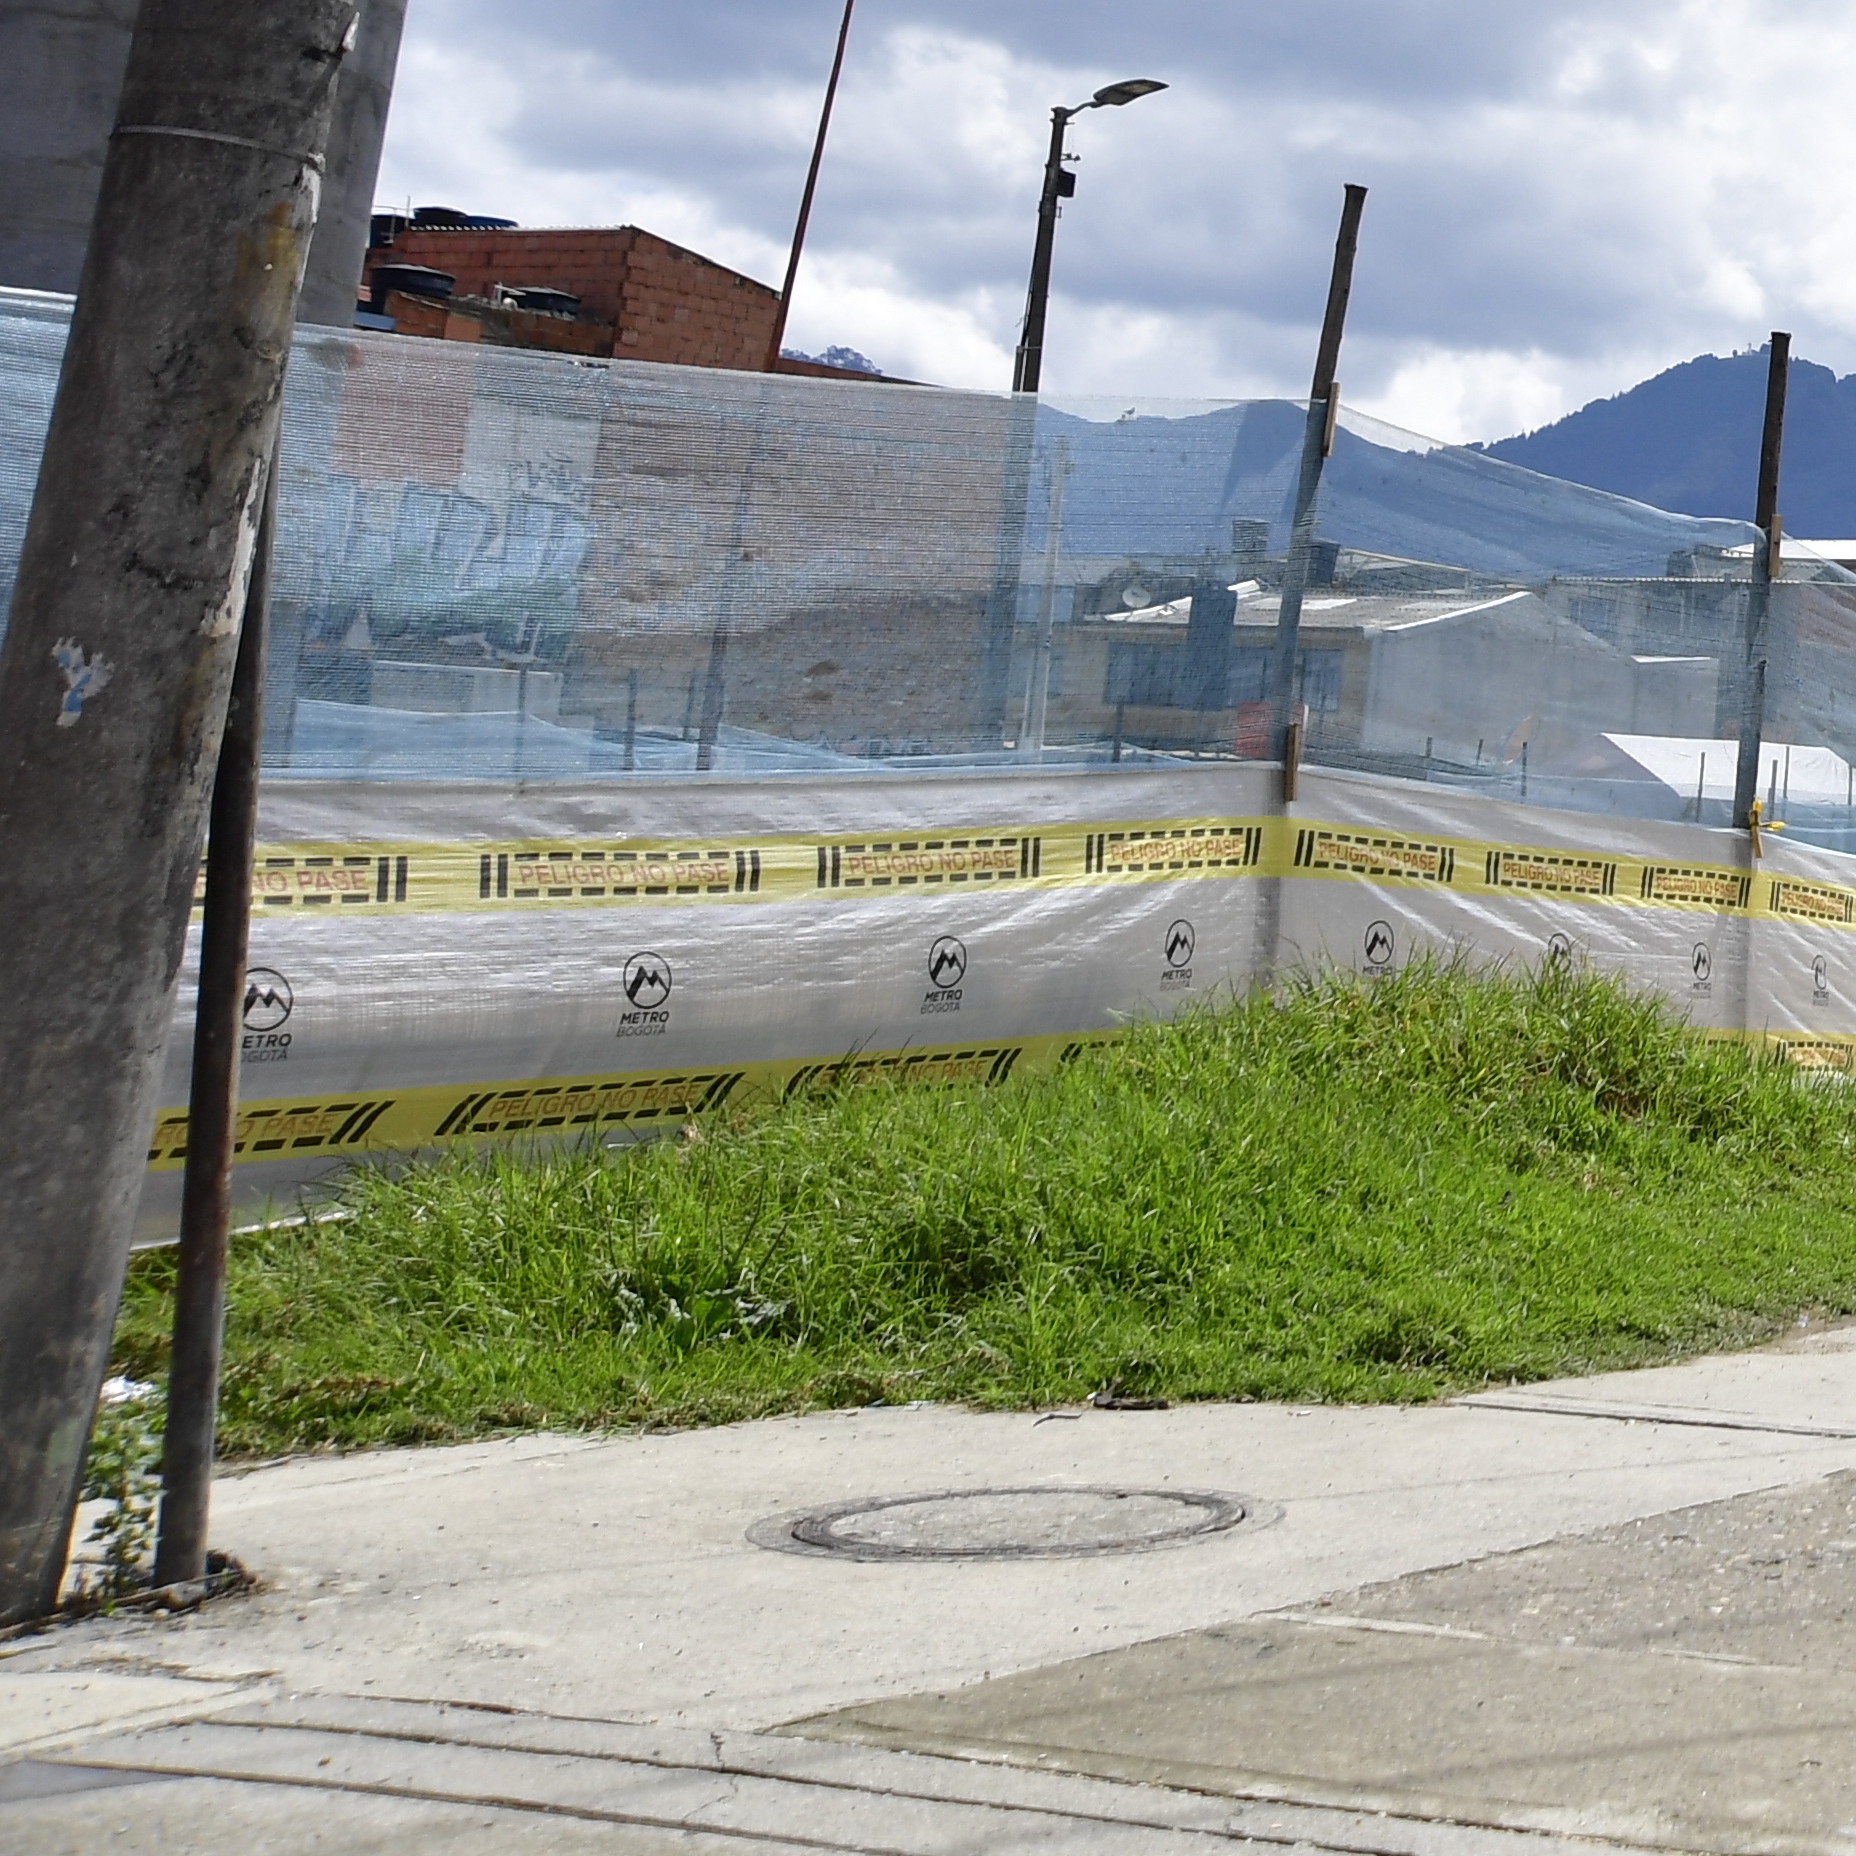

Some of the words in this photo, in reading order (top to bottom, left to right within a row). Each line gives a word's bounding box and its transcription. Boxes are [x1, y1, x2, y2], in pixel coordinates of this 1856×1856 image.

[1110, 841, 1176, 862] PELIGRO
[1179, 840, 1203, 858] NO
[1205, 838, 1241, 856] PASE
[1318, 841, 1380, 865] PELIGRO
[1380, 849, 1402, 867] NO
[1403, 852, 1436, 871] PASE
[518, 864, 624, 885] PELIGRO
[630, 863, 667, 884] NO
[671, 862, 730, 883] PASE
[849, 854, 934, 875] PELIGRO
[939, 851, 966, 872] NO
[971, 849, 1016, 870] PASE
[1503, 862, 1554, 881] PELIGRO
[296, 870, 369, 892] PASE
[923, 988, 963, 1003] METRO
[620, 1010, 670, 1024] METRO
[242, 1033, 292, 1049] ETRO
[488, 1091, 597, 1119] PELIGRO
[599, 1089, 638, 1111] NO
[261, 1113, 339, 1138] PASE
